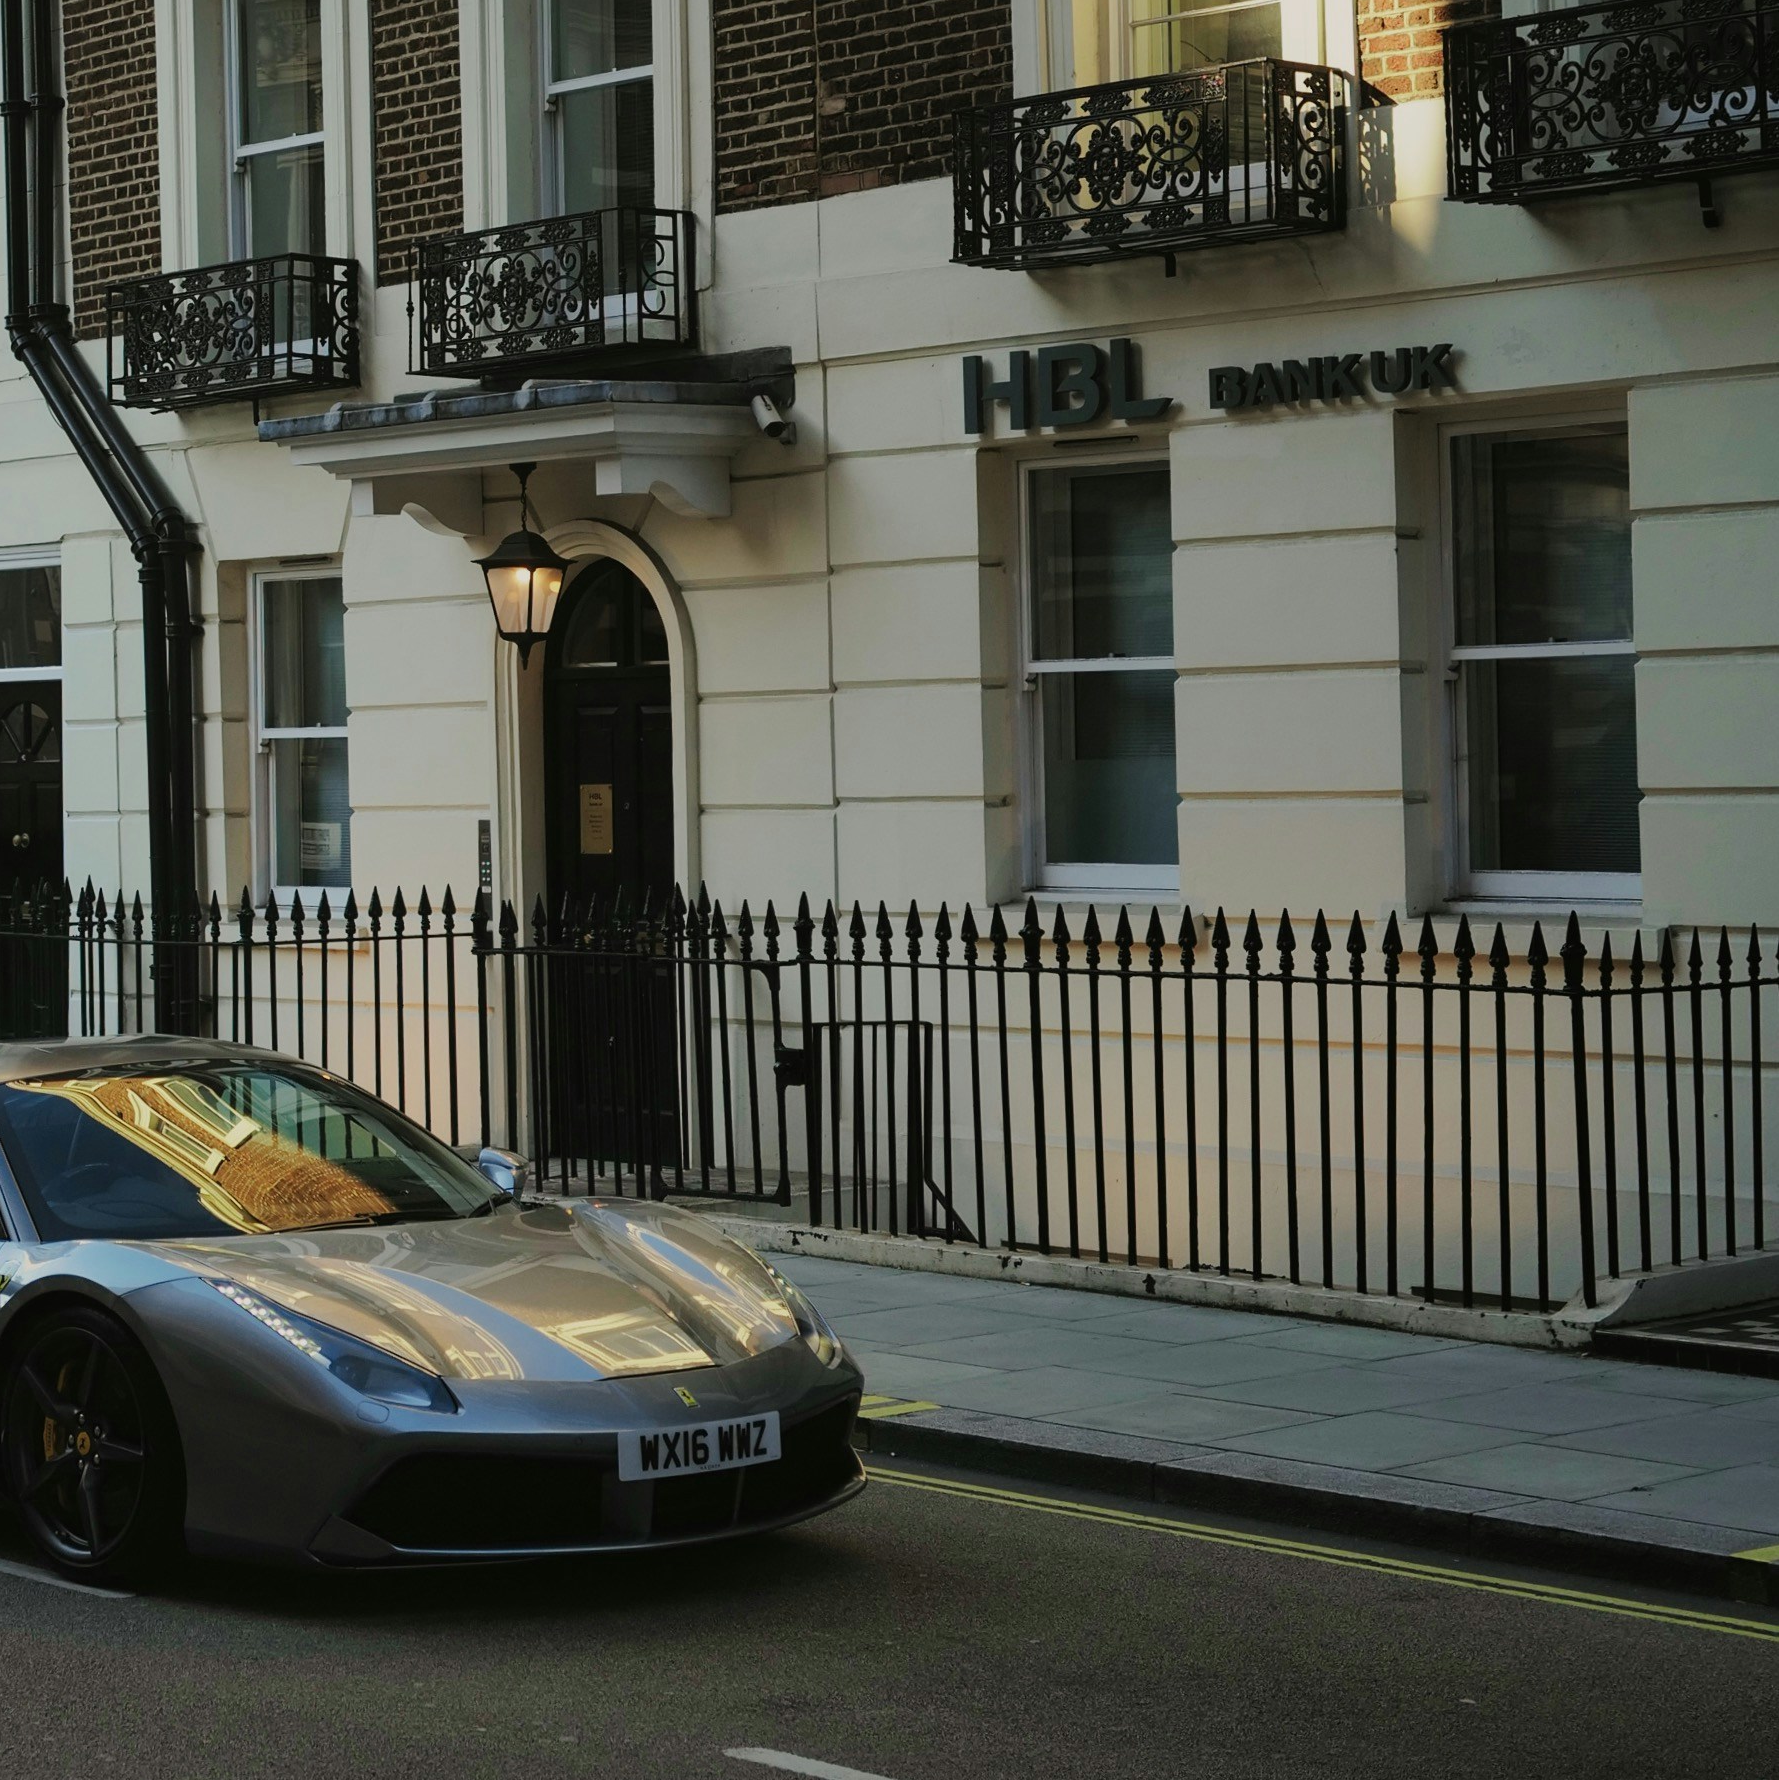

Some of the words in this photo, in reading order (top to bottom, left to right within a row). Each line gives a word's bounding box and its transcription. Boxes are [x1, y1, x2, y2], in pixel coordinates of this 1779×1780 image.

[962, 337, 1174, 435] HBL
[1208, 353, 1363, 410] BANK
[1370, 343, 1455, 394] UK
[640, 1428, 709, 1471] WX16
[718, 1419, 767, 1462] WWZ
